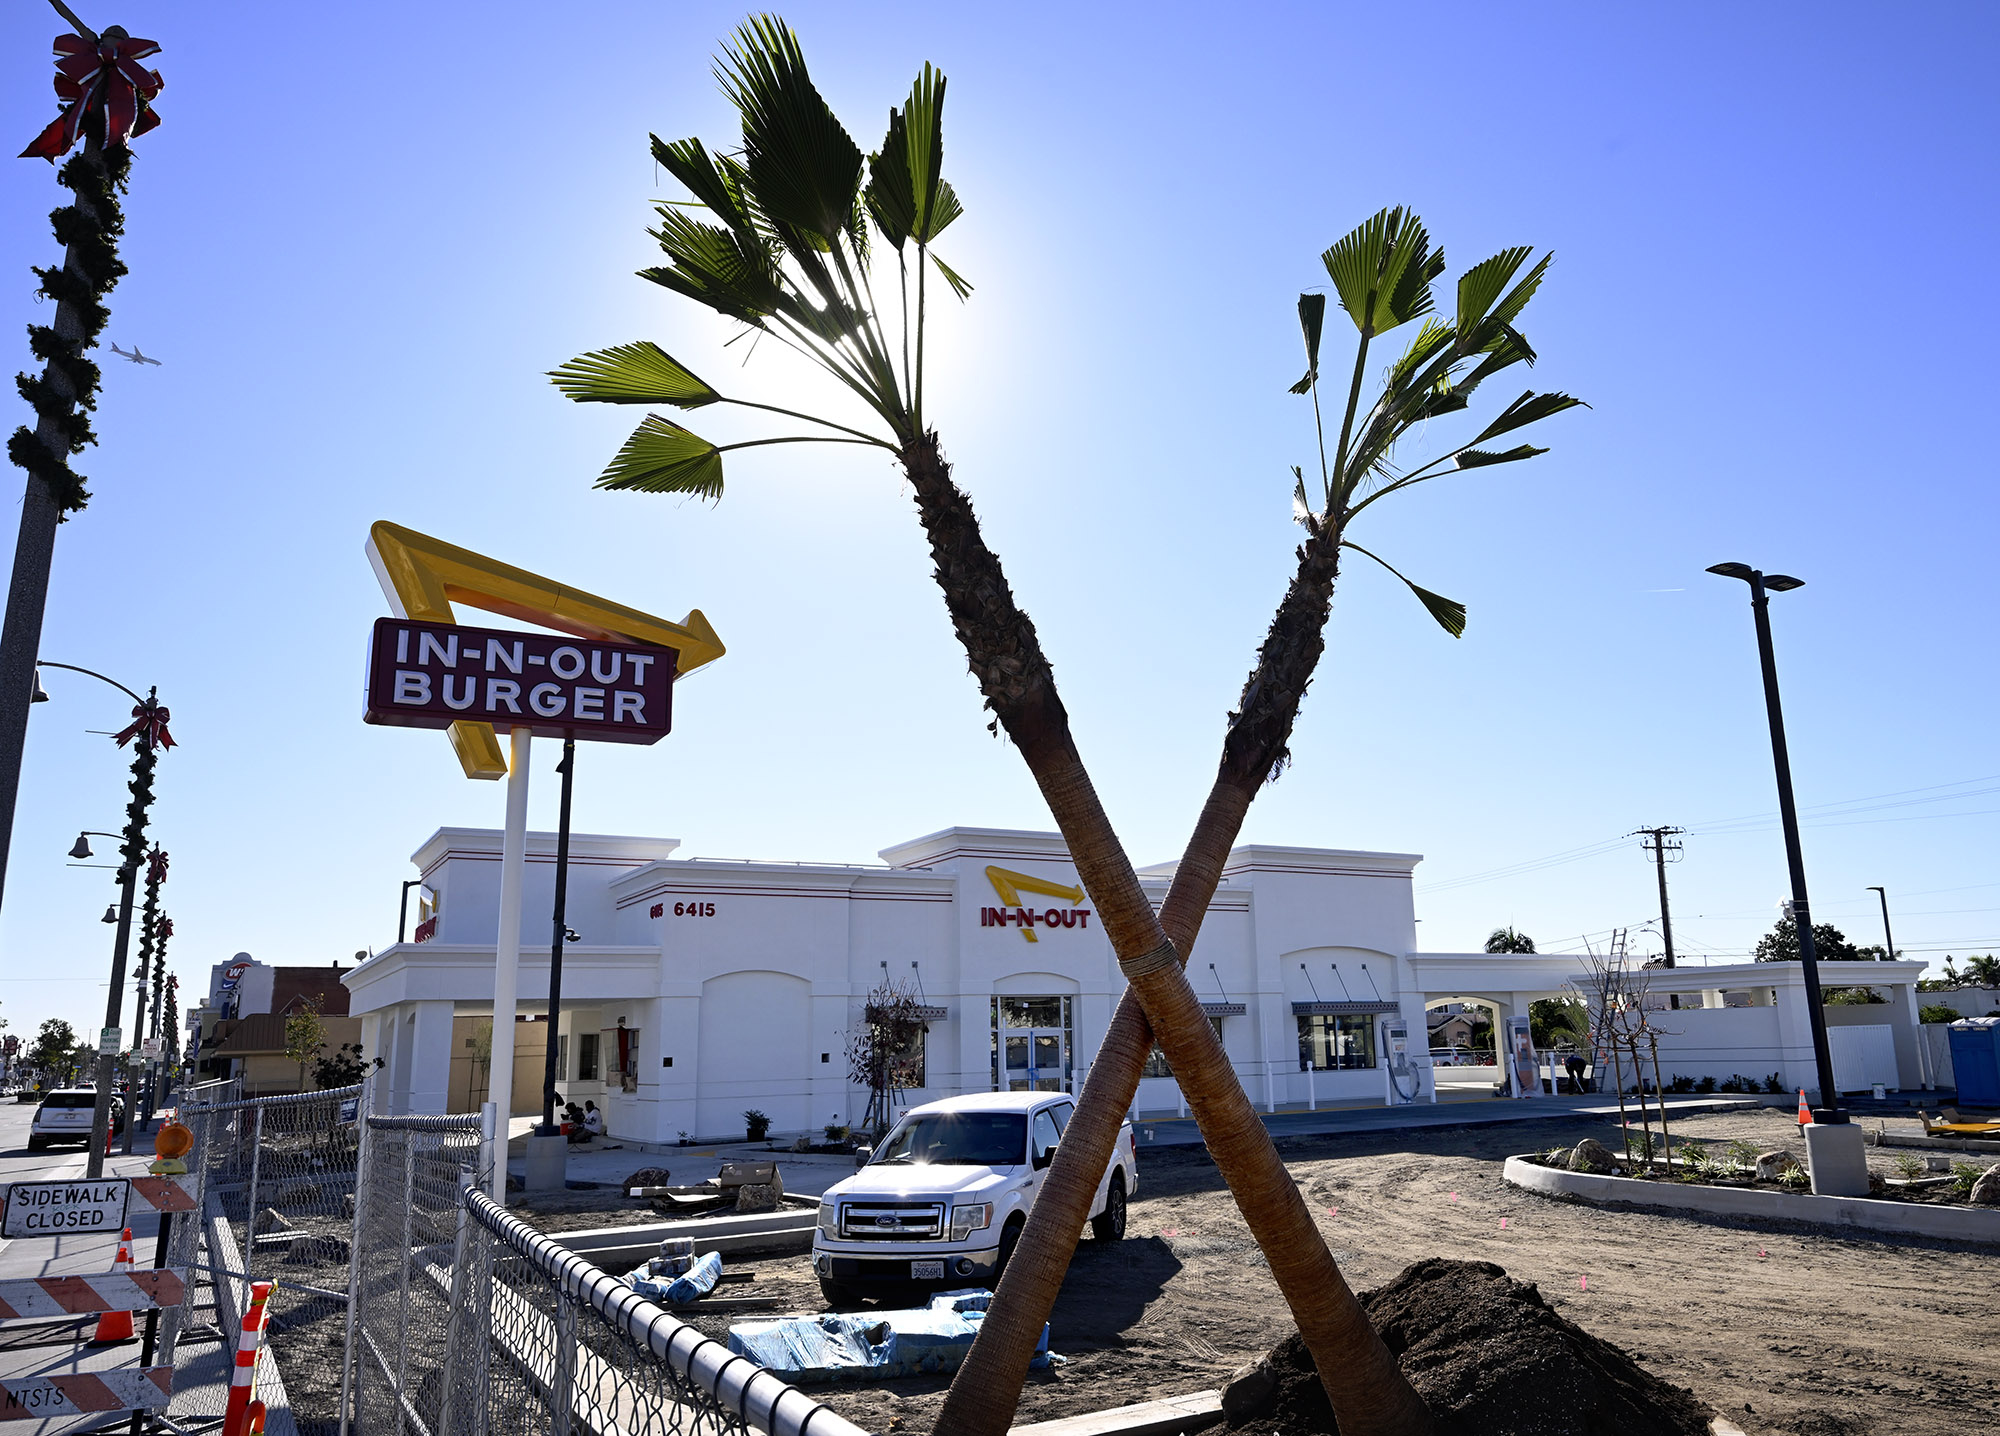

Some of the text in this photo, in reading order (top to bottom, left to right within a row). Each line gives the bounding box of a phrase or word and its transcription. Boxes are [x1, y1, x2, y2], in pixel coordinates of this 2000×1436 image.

[396, 629, 655, 687] IN-N-OUT
[393, 669, 648, 724] BURGER
[674, 902, 715, 917] 6415
[981, 907, 1091, 928] IN-N-OUT
[18, 1186, 118, 1206] SIDEWALK
[26, 1210, 104, 1229] CLOSED
[5, 1386, 65, 1409] NTSTS
